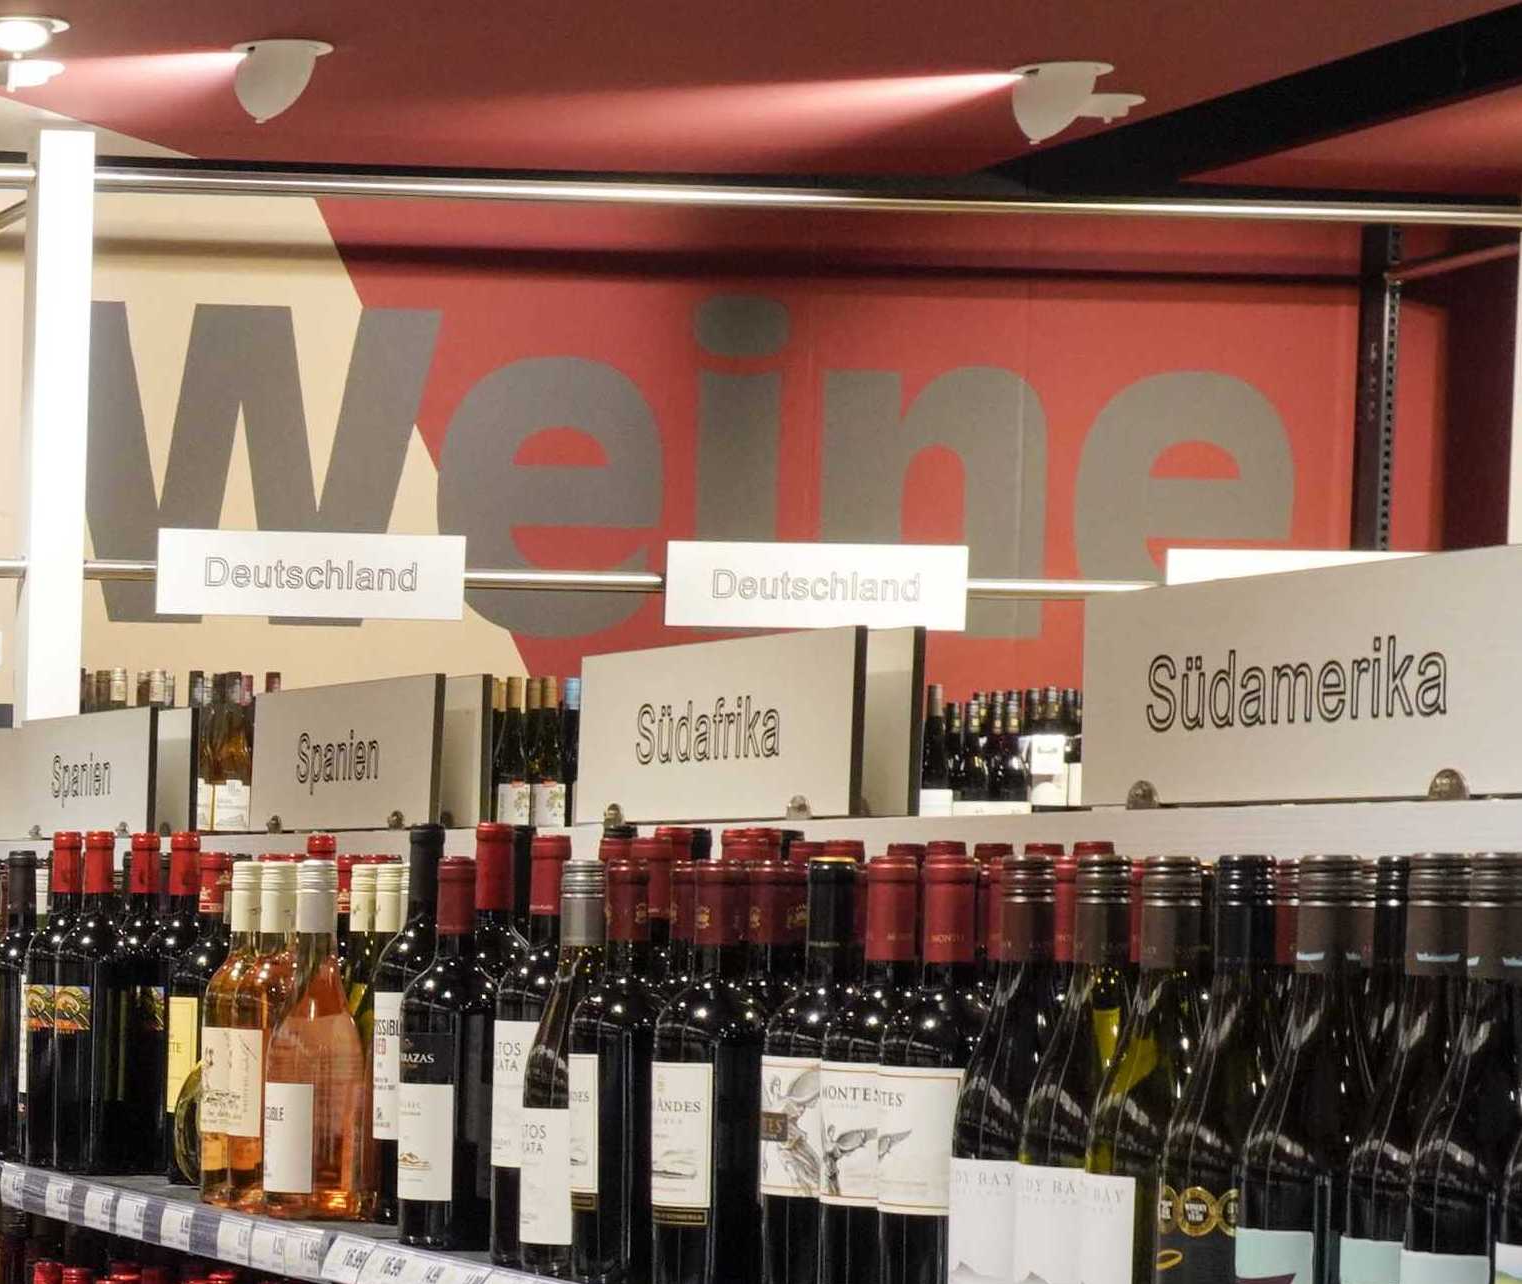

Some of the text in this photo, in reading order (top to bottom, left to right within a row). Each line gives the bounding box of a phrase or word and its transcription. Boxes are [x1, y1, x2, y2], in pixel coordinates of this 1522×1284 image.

[204, 557, 418, 593] Deutschland
[712, 569, 921, 603] Deutschland
[1144, 636, 1448, 732] Südamerika
[635, 696, 780, 766] Südafrika
[51, 752, 112, 808] Spanien
[296, 729, 379, 795] Spanien
